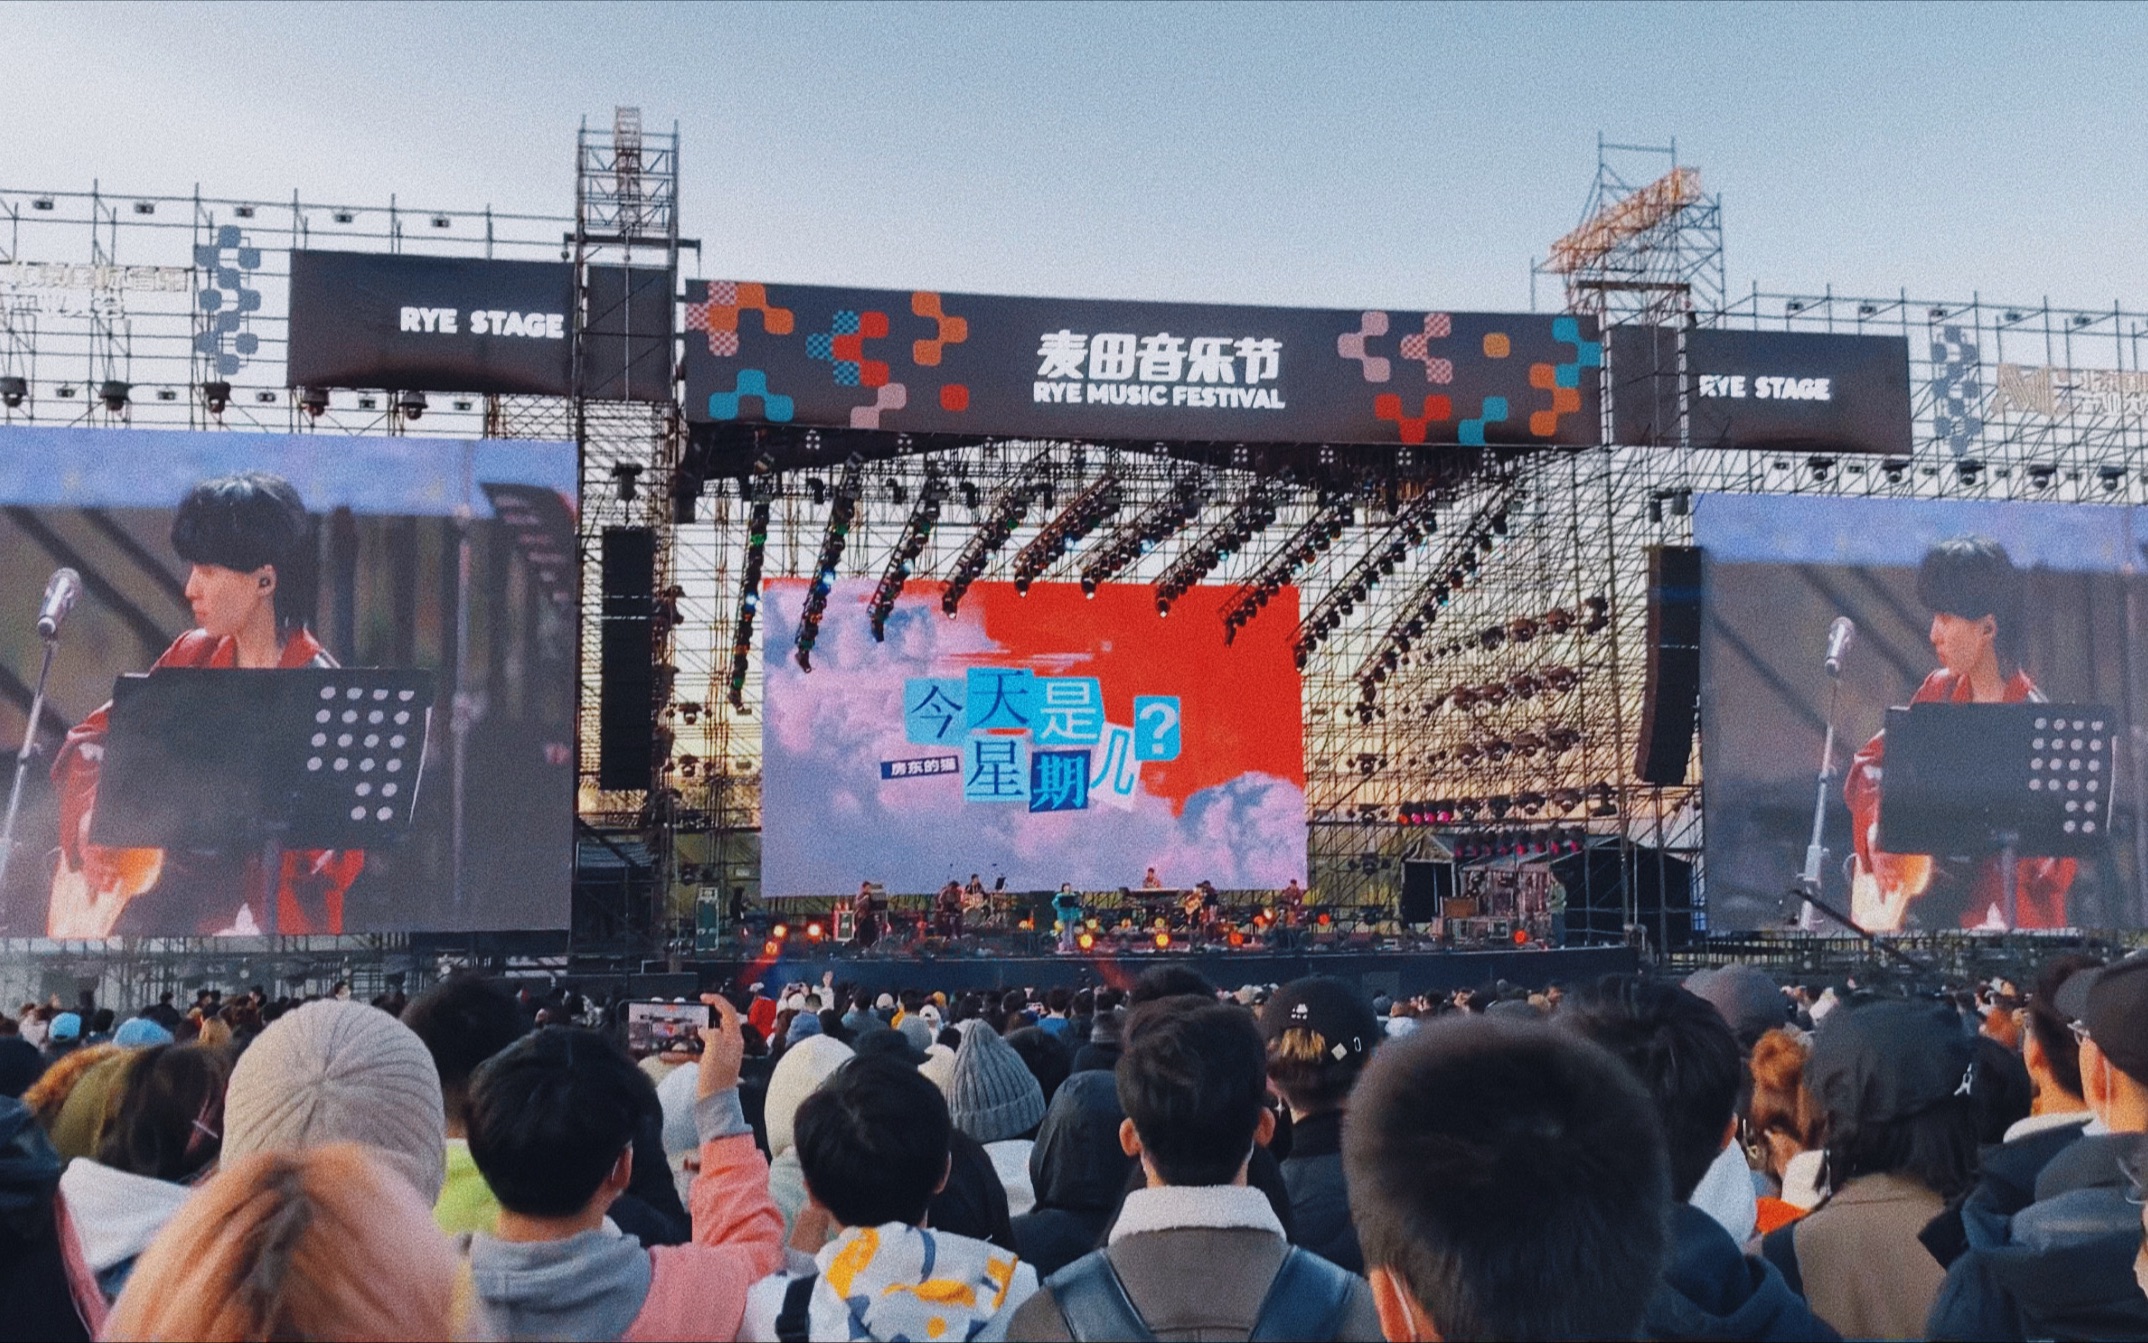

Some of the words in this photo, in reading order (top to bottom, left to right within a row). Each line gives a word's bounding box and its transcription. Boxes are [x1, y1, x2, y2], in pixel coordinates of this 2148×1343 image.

[400, 306, 458, 333] RYE
[470, 310, 565, 339] STAGE
[1036, 329, 1283, 384] 麦田音乐节
[1033, 381, 1082, 403] RYE
[1086, 383, 1168, 406] MUSIC
[1172, 386, 1286, 410] FESTIVAL
[1699, 375, 1746, 399] RYE
[1754, 376, 1831, 400] STAGE
